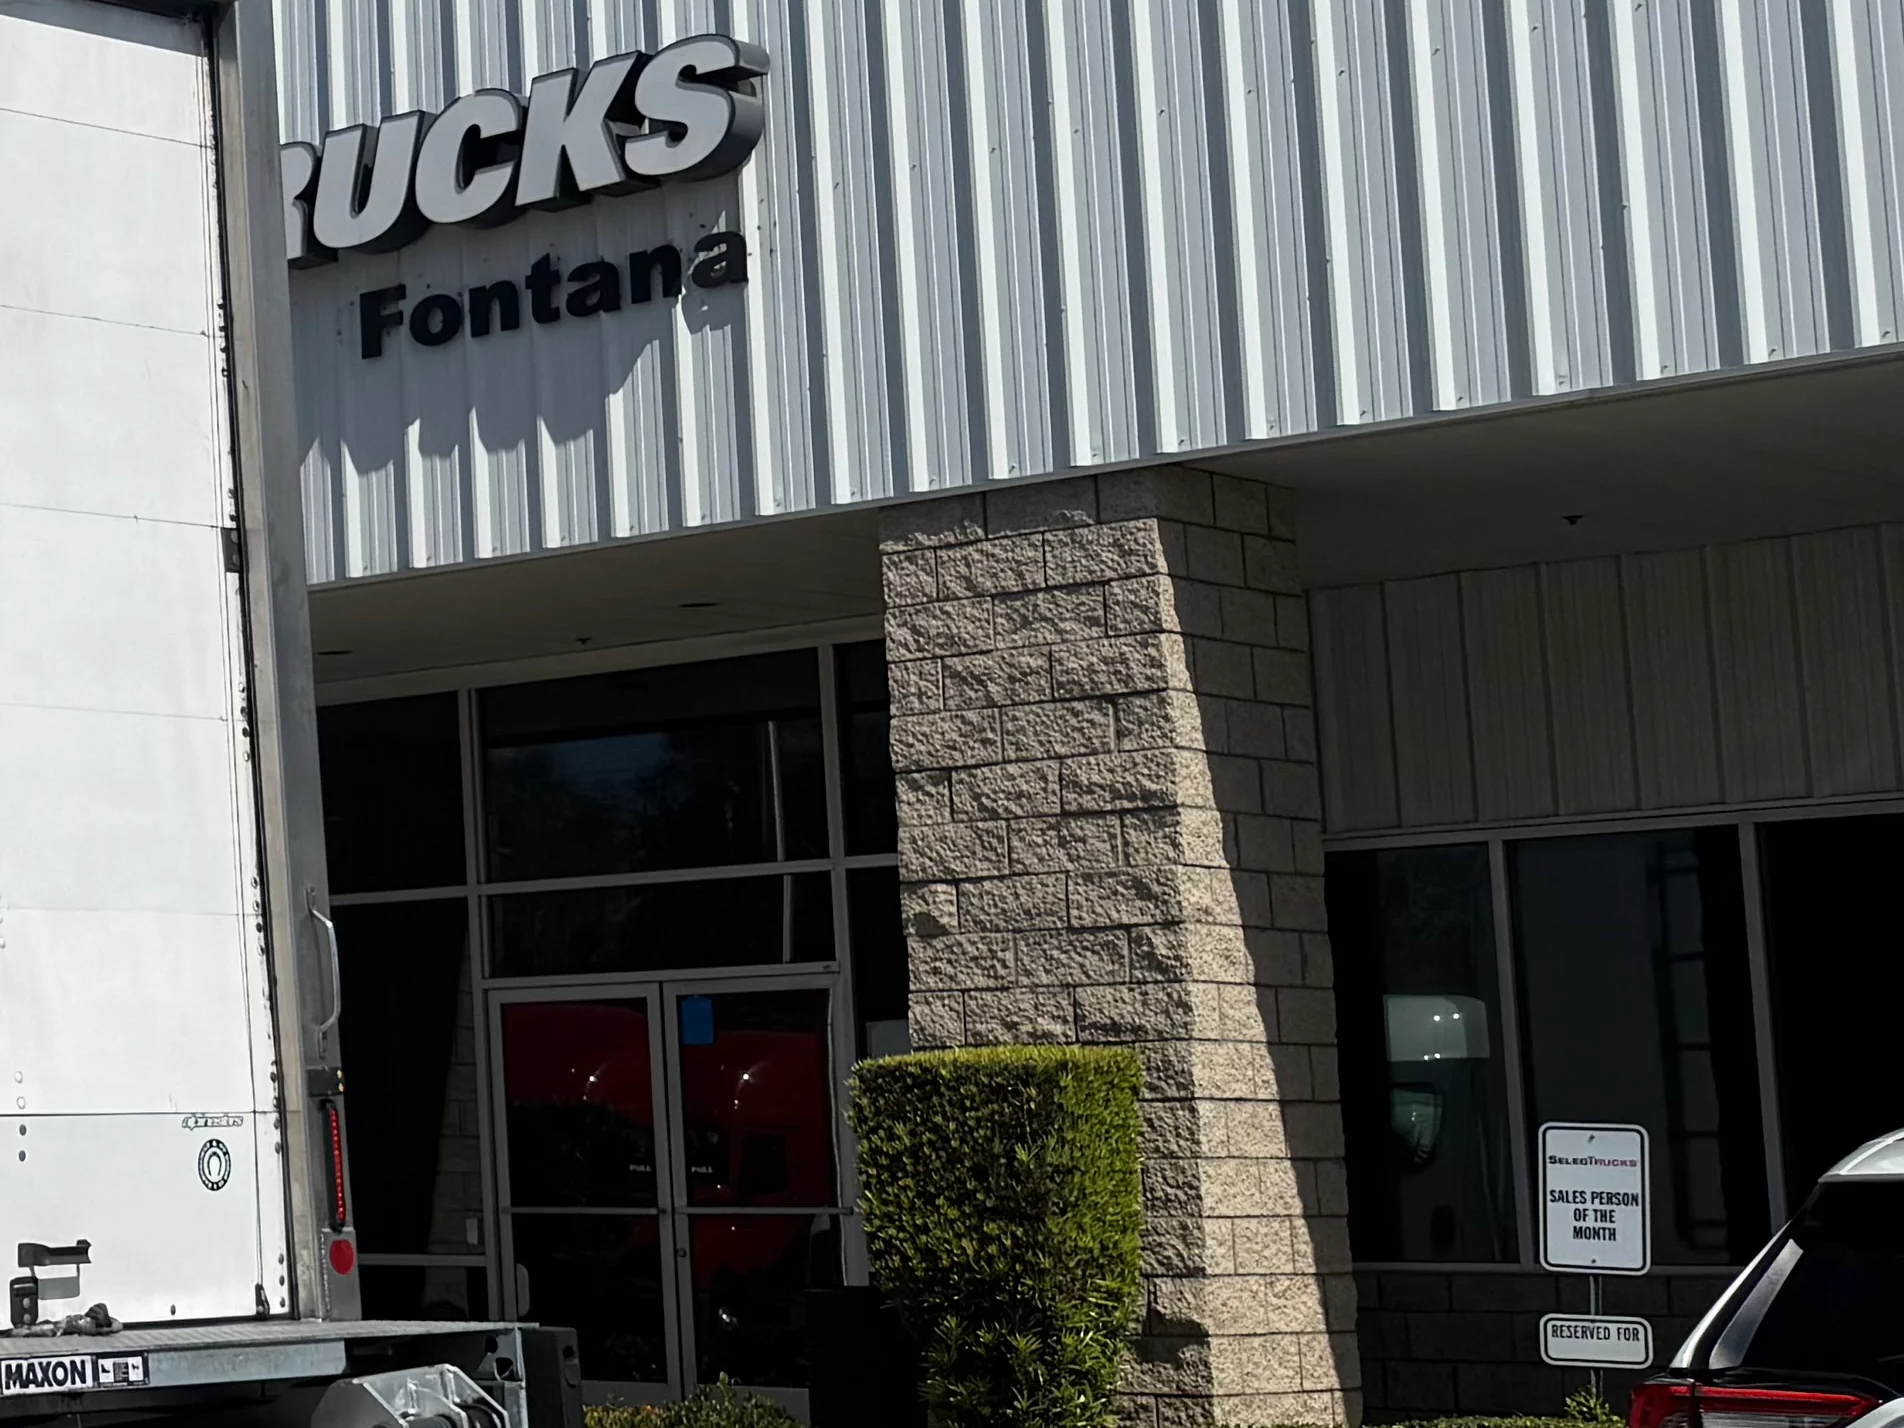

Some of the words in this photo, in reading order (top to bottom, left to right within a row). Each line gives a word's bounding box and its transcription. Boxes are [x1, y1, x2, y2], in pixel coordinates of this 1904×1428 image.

[359, 229, 749, 360] Fontana
[1549, 1189, 1587, 1204] SALES
[1590, 1190, 1639, 1207] PERSON
[1573, 1207, 1590, 1222] OF
[1592, 1208, 1616, 1223] THE
[1572, 1225, 1617, 1241] MONTH
[1551, 1323, 1611, 1341] RESERVED
[1617, 1326, 1640, 1342] FOR
[4, 1358, 87, 1391] MAXON
